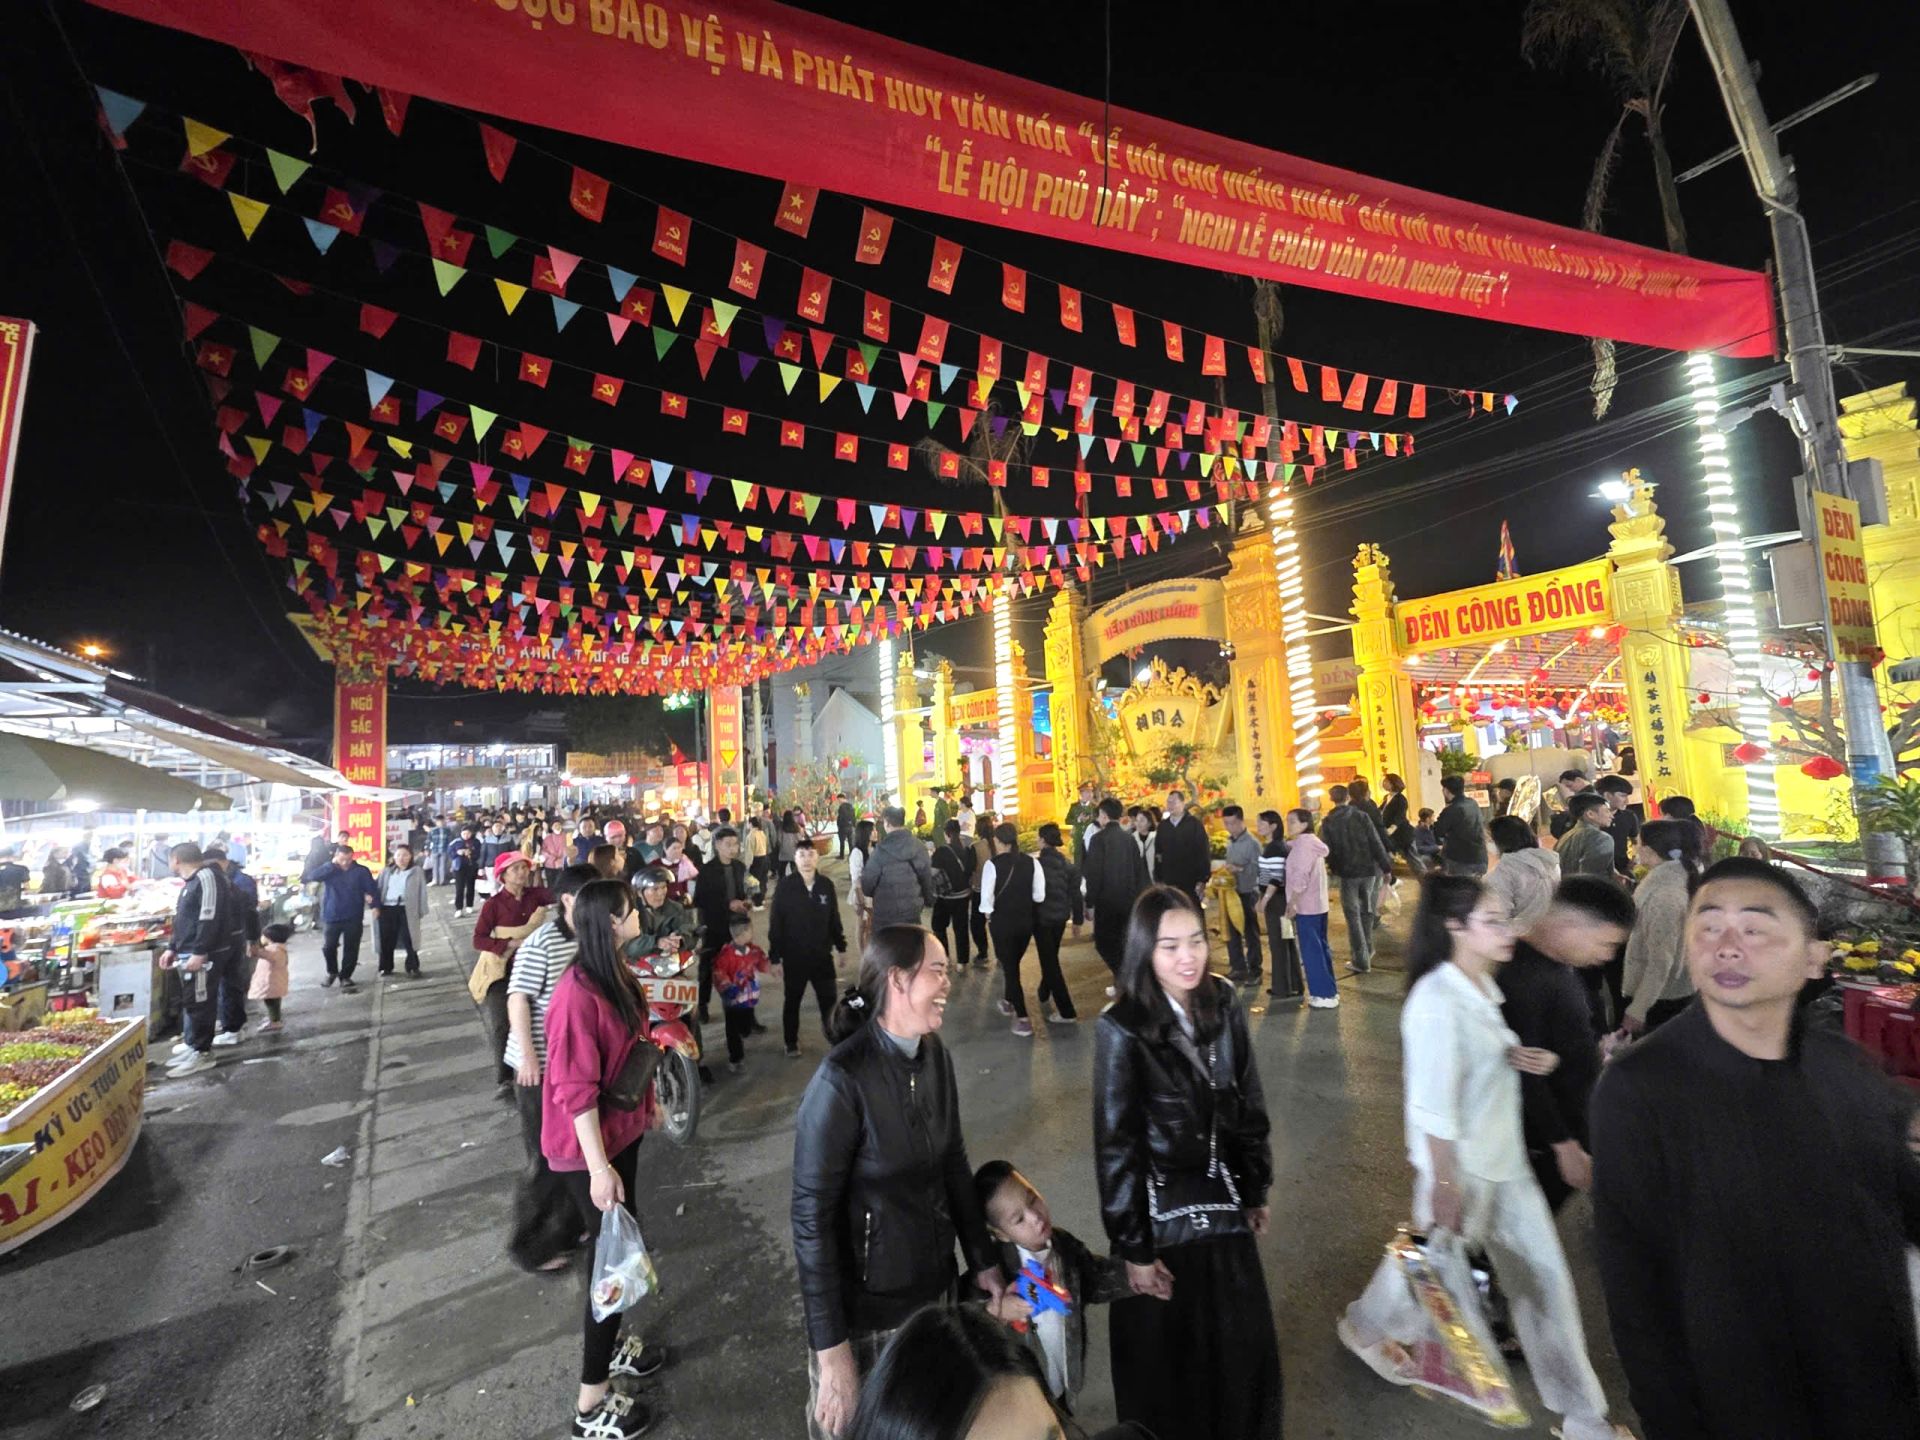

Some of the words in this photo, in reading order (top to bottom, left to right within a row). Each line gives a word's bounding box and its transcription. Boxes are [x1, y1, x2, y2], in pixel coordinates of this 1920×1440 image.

[680, 14, 726, 76] VỆ
[736, 30, 783, 80] VÀ
[792, 50, 875, 103] PHÁT
[884, 77, 943, 121] HUY
[951, 92, 1012, 140] VĂN
[1016, 112, 1073, 157] HÓA
[1126, 143, 1168, 185] HỘI
[1172, 158, 1221, 199] CHỢ
[1359, 198, 1399, 238] GẮN
[979, 156, 1029, 215] HỘI
[1032, 169, 1089, 221] PHỦ
[1237, 212, 1268, 259] LỄ
[1268, 223, 1326, 271] CHẦU
[1325, 237, 1368, 280] VĂN
[1366, 243, 1406, 289] CỦA
[1822, 500, 1855, 541] ĐỀN
[1824, 548, 1866, 585] CÔNG
[1405, 604, 1450, 645] ĐỀN
[1457, 596, 1521, 635] CÔNG
[1526, 577, 1605, 623] ĐỒNG
[1829, 587, 1873, 628] ĐỒNG
[662, 981, 697, 1002] ÔM
